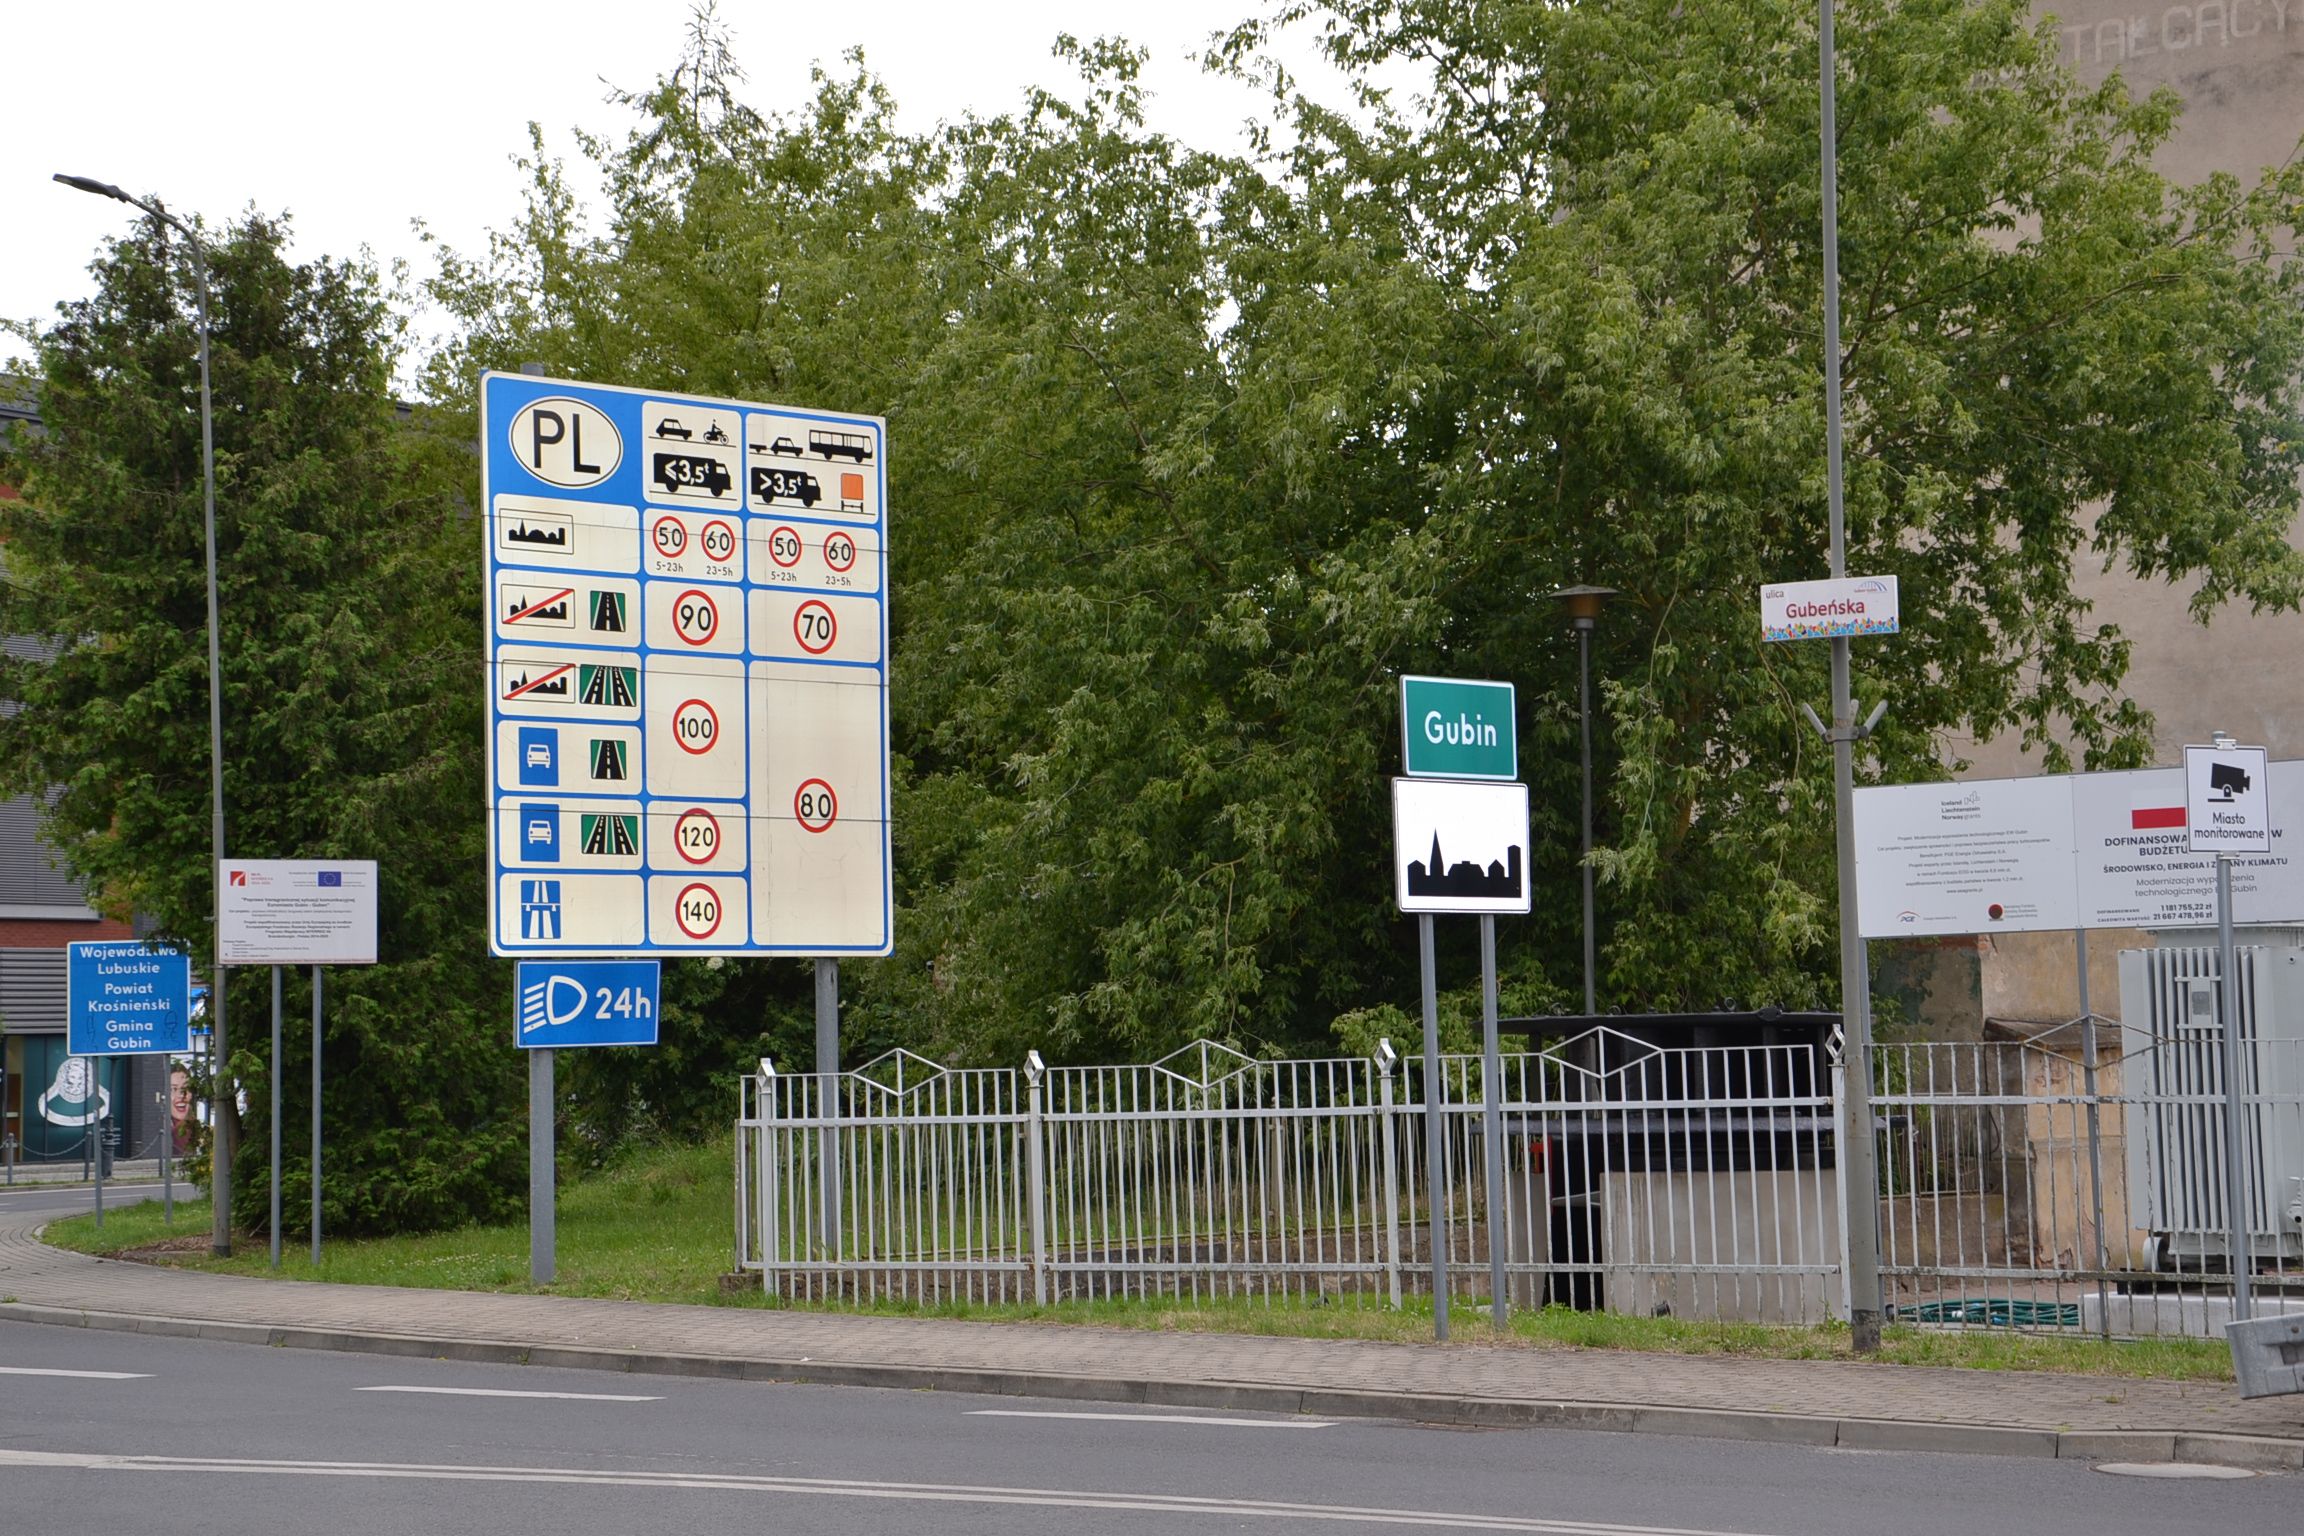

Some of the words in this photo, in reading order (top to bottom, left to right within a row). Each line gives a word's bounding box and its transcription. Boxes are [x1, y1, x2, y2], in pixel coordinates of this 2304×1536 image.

[533, 409, 601, 475] PL
[658, 526, 683, 547] 50
[706, 531, 730, 551] 60
[774, 537, 798, 557] 50
[828, 542, 851, 562] 60
[655, 561, 684, 573] 5-23h
[706, 565, 734, 577] 23-5h
[770, 571, 798, 582] 5-23h
[825, 575, 852, 587] 23-5h
[1765, 590, 1785, 599] ulica
[1786, 598, 1865, 619] Gubeńska
[680, 604, 713, 632] 90
[802, 614, 831, 640] 70
[679, 717, 713, 739] 100
[1424, 710, 1498, 747] Gubin
[800, 793, 831, 818] 80
[2212, 811, 2247, 825] Miasto
[681, 826, 714, 847] 120
[2194, 826, 2266, 839] monitorowane
[2138, 845, 2188, 857] BUDŻETU
[2103, 863, 2166, 875] ŚRODOWISKO,
[2167, 861, 2205, 871] ENERGIA
[2247, 857, 2289, 868] KLIMATU
[2136, 876, 2195, 888] Modernizacja
[2135, 886, 2214, 898] technologicznego
[683, 900, 715, 922] 140
[97, 962, 161, 975] Lubuskie
[105, 982, 153, 995] Powiat
[88, 998, 171, 1012] Krośnieński
[595, 986, 652, 1020] 24h
[105, 1019, 153, 1032] Gmina
[107, 1036, 152, 1049] Gubin
